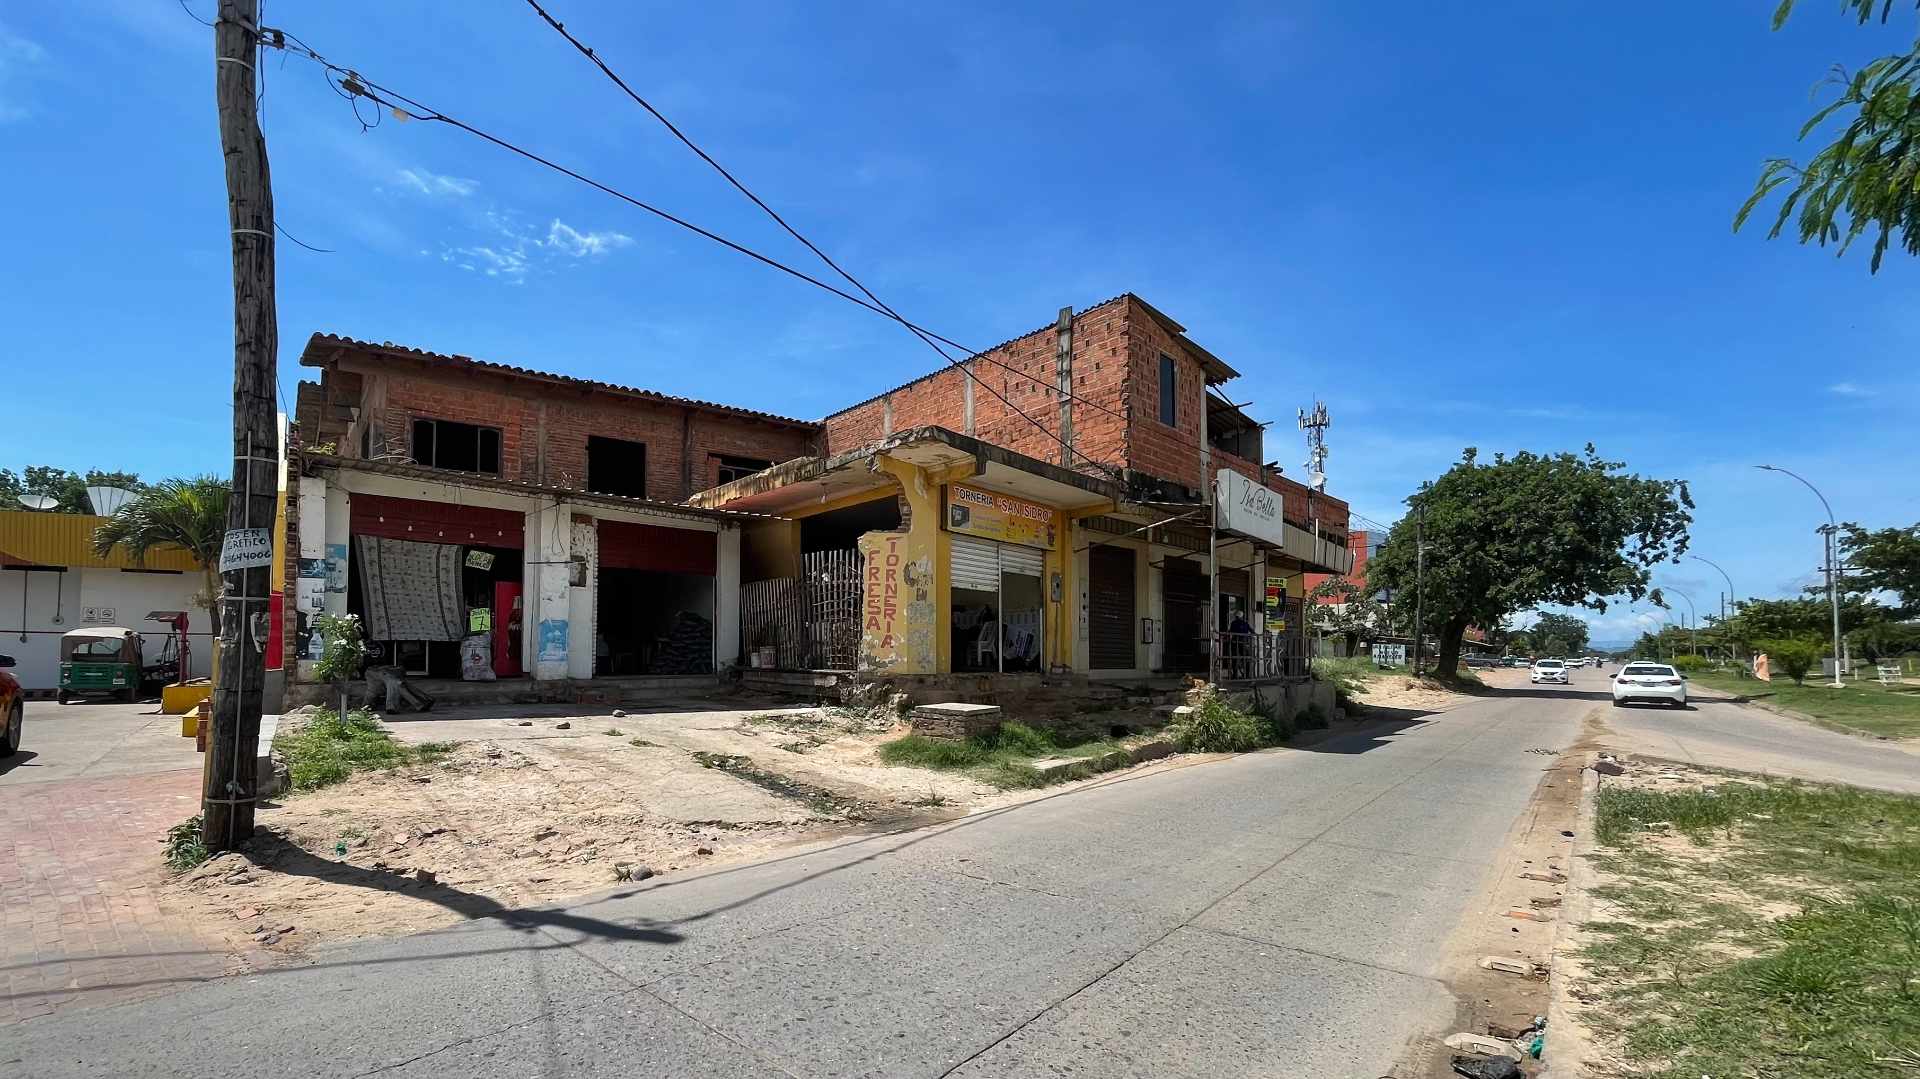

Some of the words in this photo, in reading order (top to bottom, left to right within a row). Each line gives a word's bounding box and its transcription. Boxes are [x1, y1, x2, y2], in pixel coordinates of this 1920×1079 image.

[953, 486, 994, 506] TORNERIA
[243, 530, 260, 538] EN
[866, 550, 881, 631] FRESA
[881, 536, 902, 649] TORNERIA
